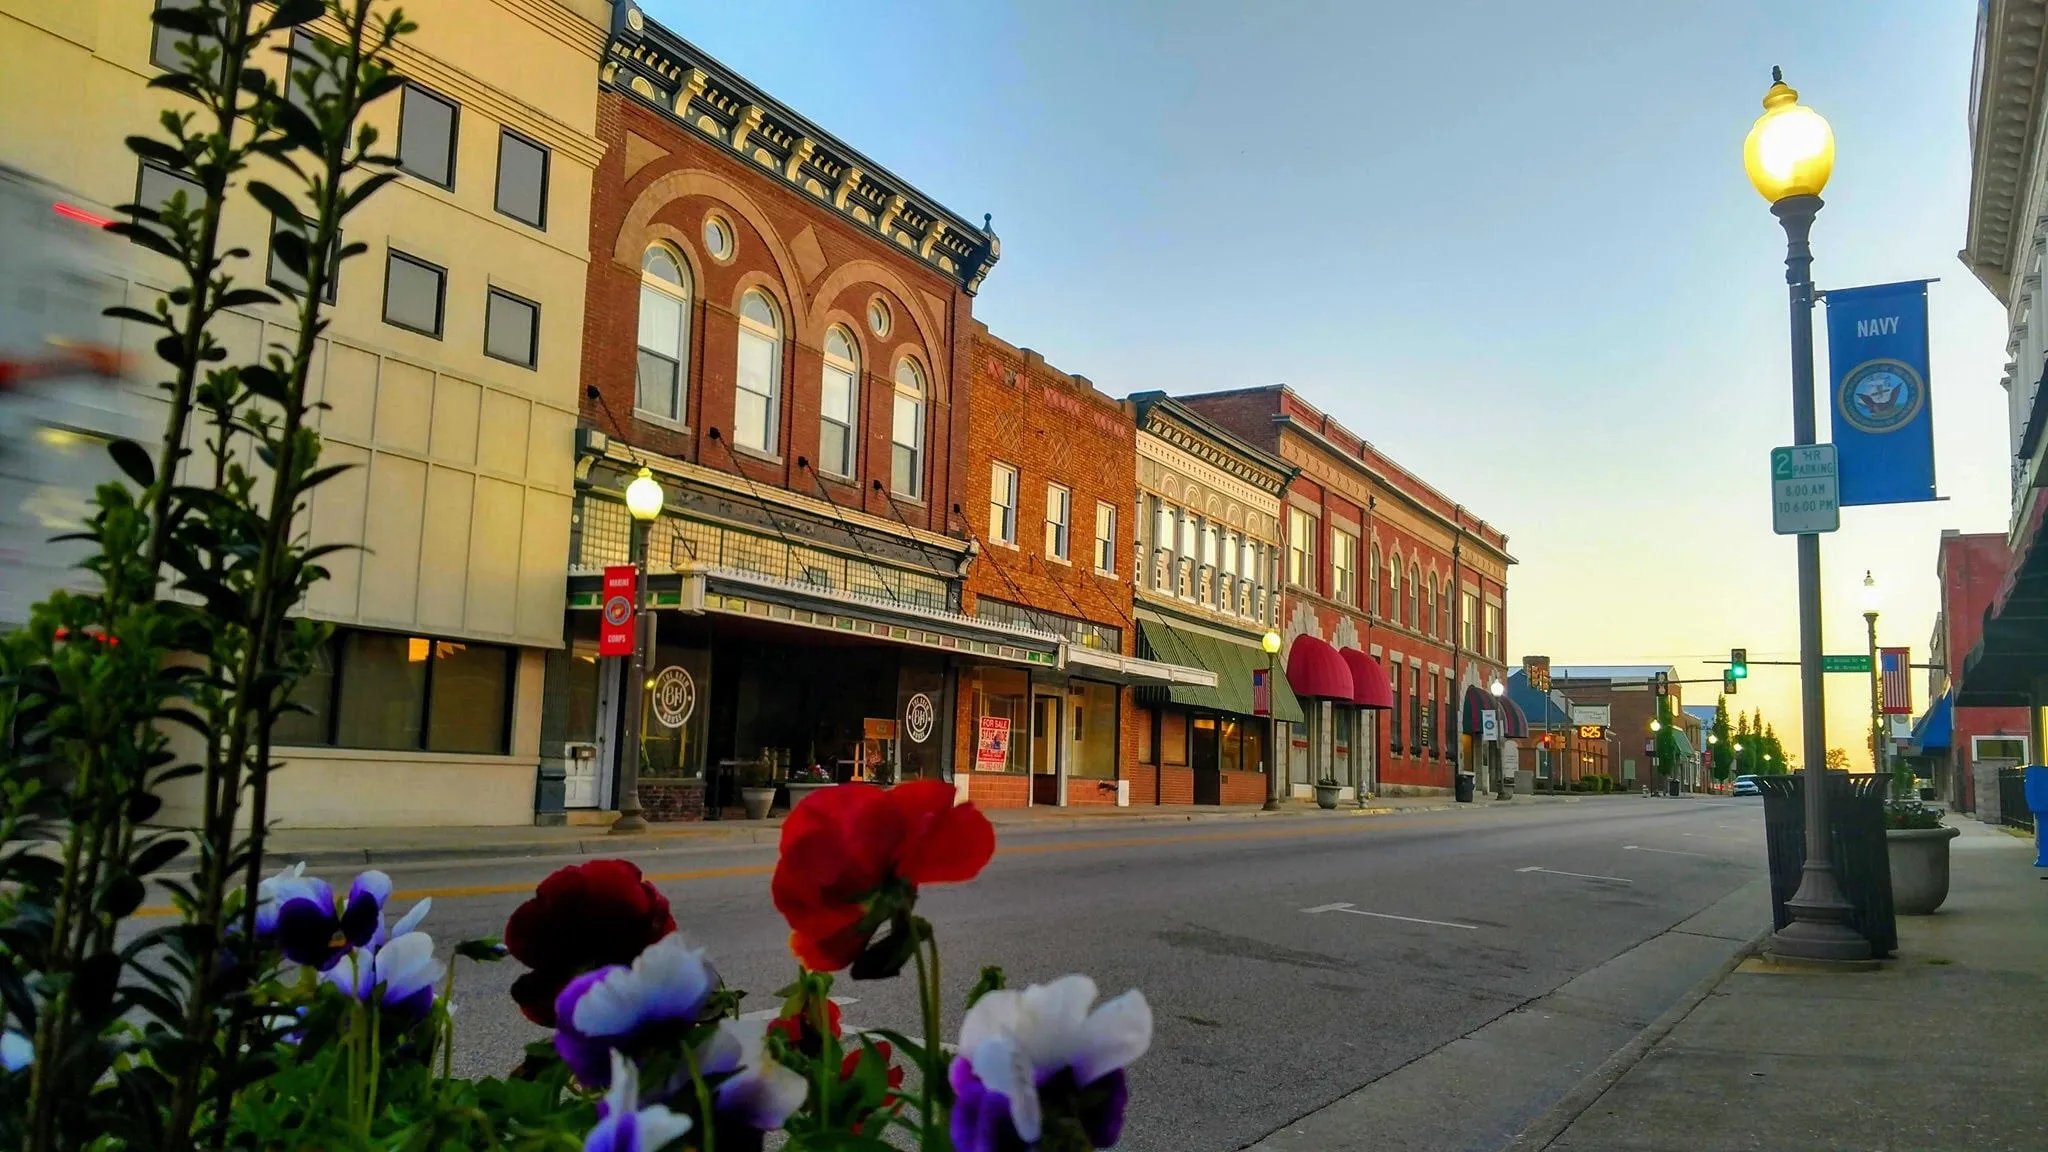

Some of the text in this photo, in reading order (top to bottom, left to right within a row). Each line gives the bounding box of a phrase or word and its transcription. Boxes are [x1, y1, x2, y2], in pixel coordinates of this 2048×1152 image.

[1857, 316, 1900, 338] NAVY
[1776, 452, 1790, 475] 2
[1793, 462, 1833, 475] PARKING
[1811, 483, 1825, 495] AM
[1779, 502, 1791, 513] TO
[1819, 500, 1834, 511] PM
[608, 634, 626, 643] CORPS
[983, 718, 1008, 730] FOR SALE
